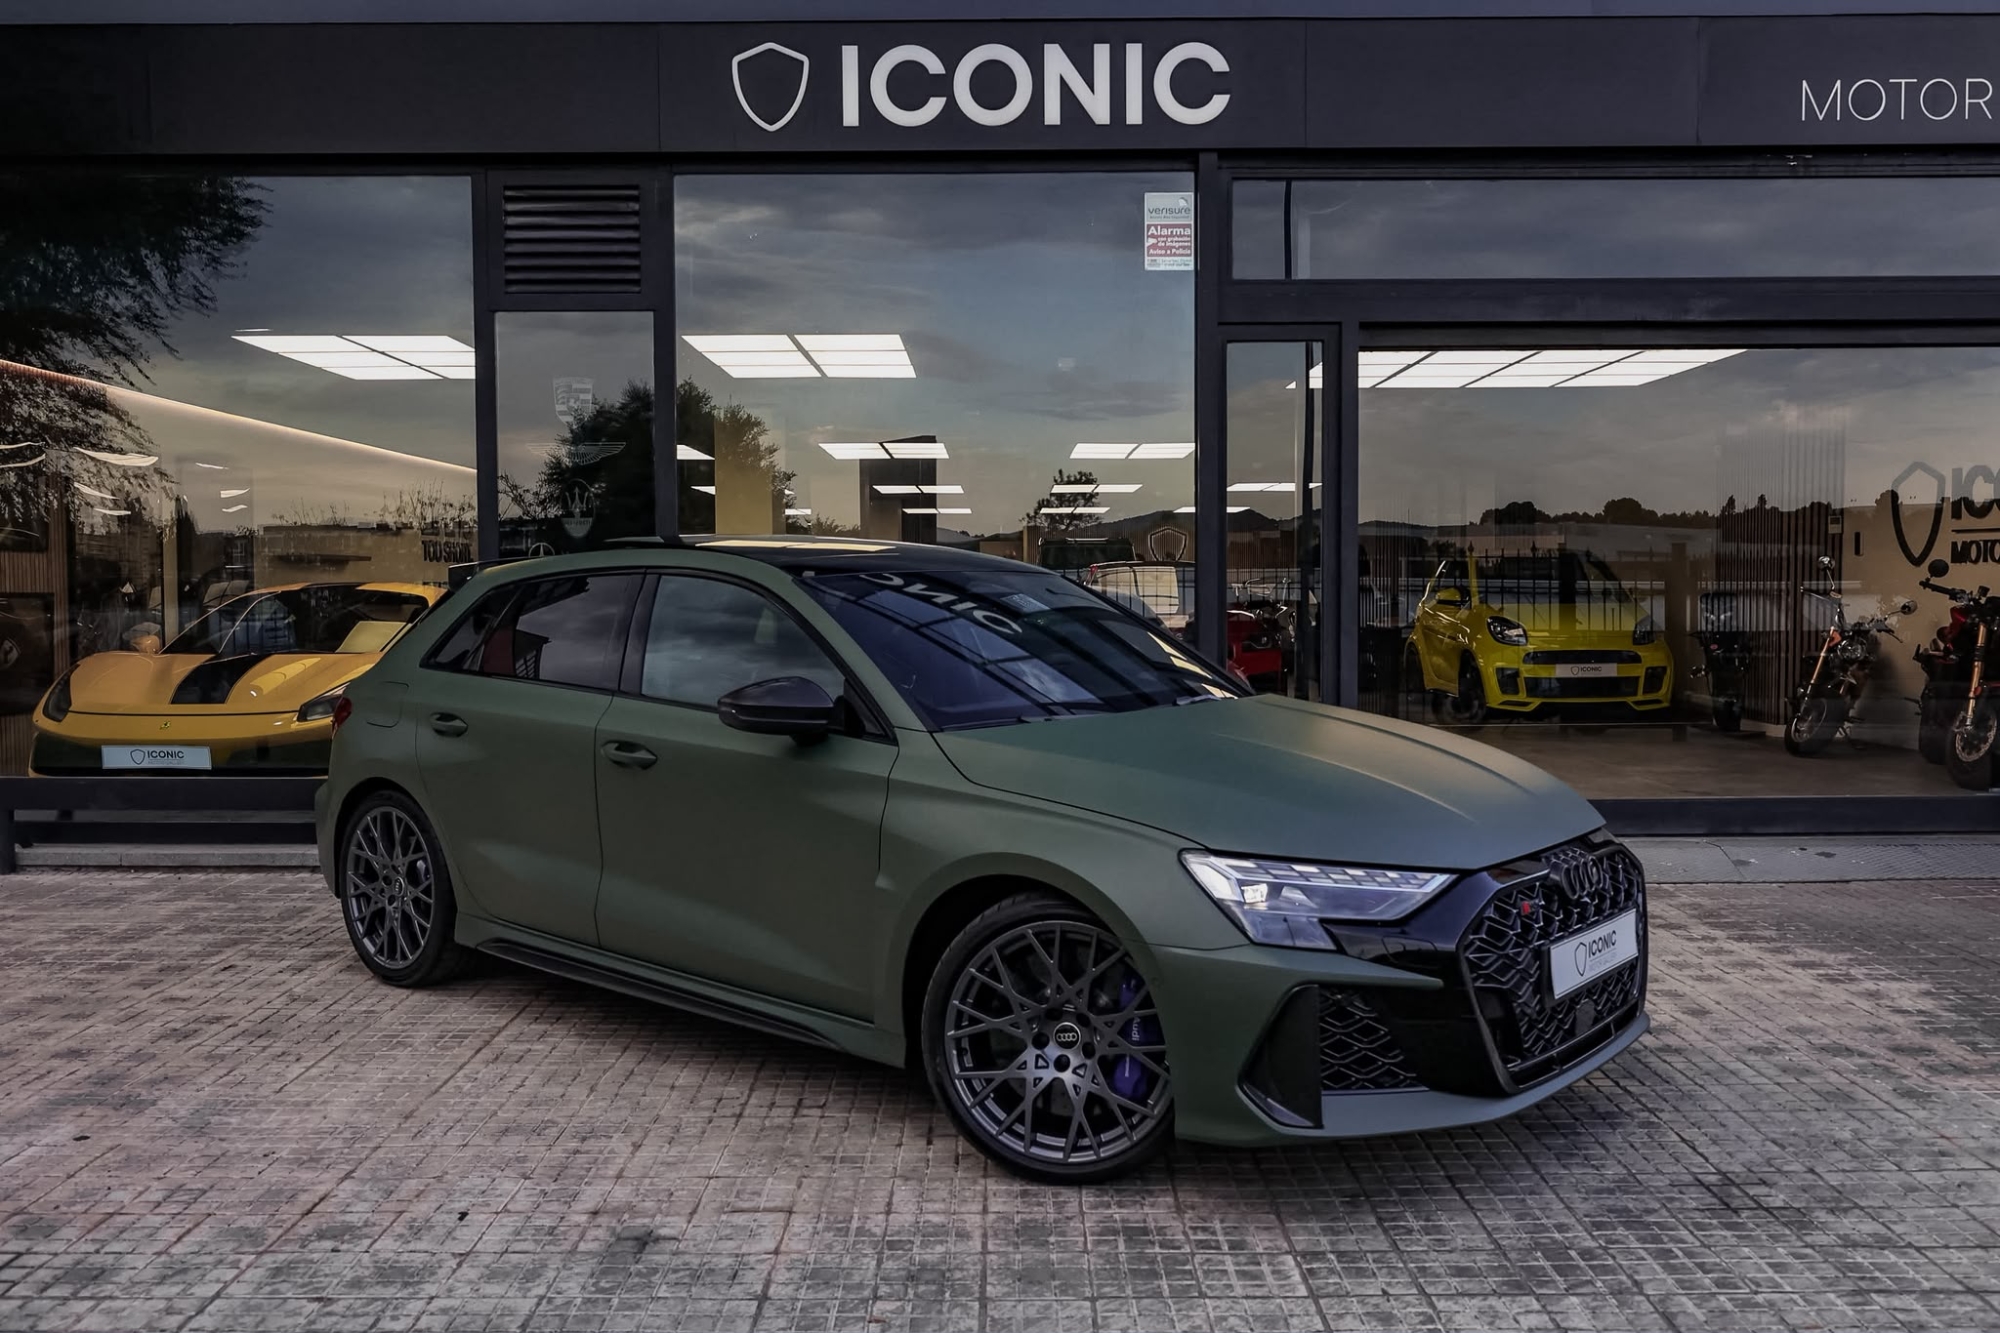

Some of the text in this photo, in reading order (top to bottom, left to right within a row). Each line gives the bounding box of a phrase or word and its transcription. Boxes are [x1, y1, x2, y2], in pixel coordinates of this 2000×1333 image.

[841, 41, 1231, 127] ICONIC
[1800, 77, 1994, 122] MOTOR
[1148, 207, 1191, 215] verisure
[1148, 225, 1191, 236] Alarma
[1952, 465, 2000, 520] IC
[1580, 665, 1603, 673] ICONIC
[147, 750, 185, 760] ICONIC
[1588, 930, 1617, 958] ICONIC
[1131, 1017, 1141, 1042] Audi
